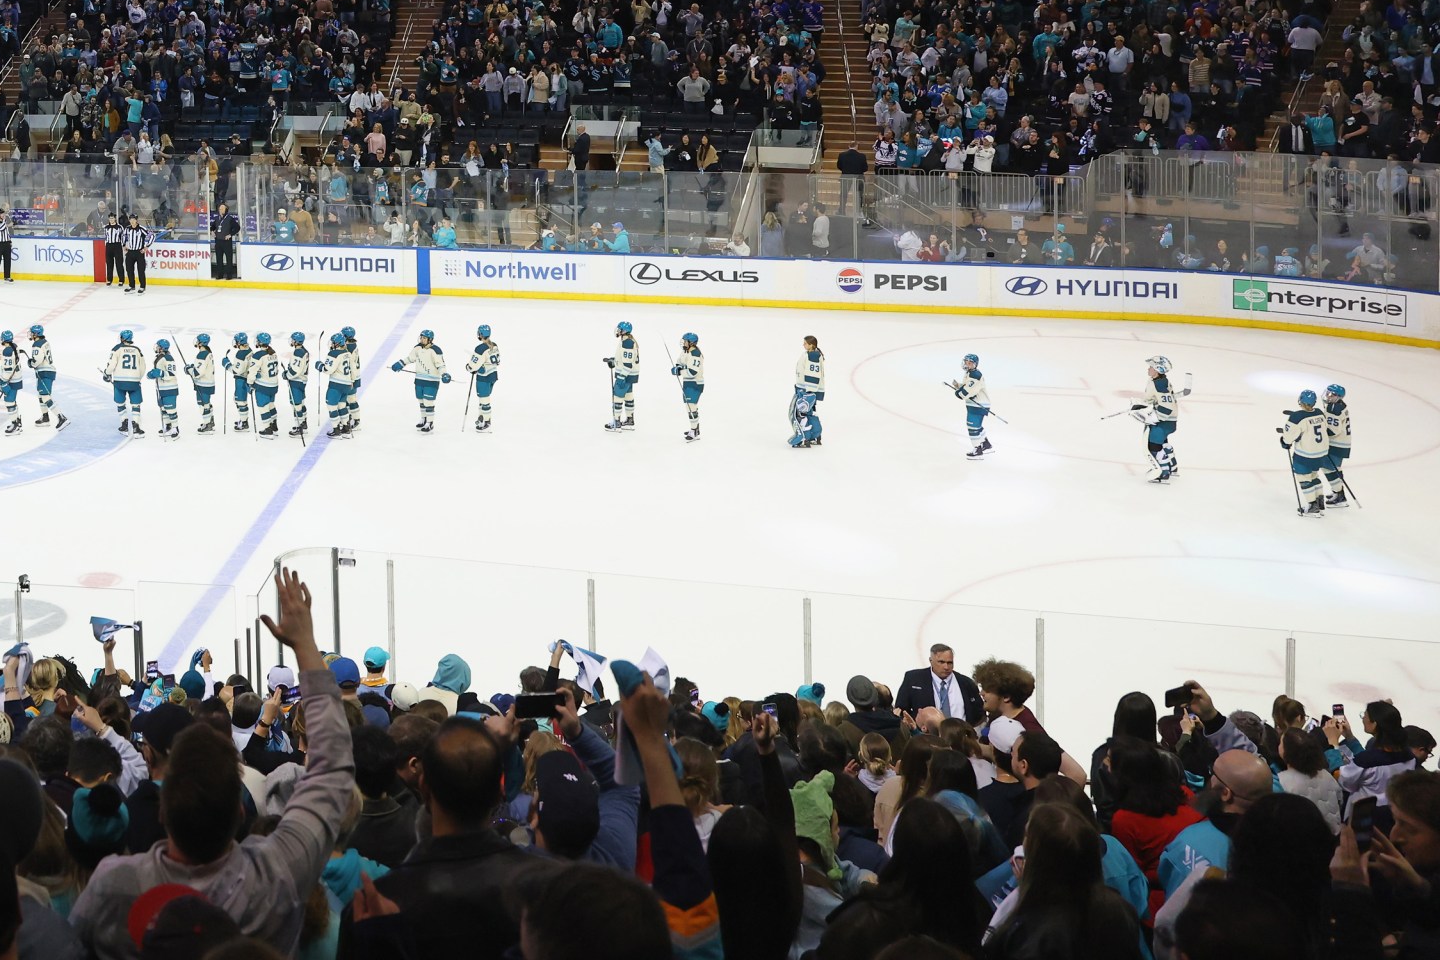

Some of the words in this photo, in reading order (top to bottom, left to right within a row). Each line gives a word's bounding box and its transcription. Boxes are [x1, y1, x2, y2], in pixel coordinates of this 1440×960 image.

[34, 244, 84, 266] Infosys
[155, 249, 176, 259] FOR
[160, 261, 201, 271] DUNKIN'
[300, 256, 395, 275] HYUNDAI
[465, 260, 578, 282] Northwell
[665, 267, 760, 284] LEXUS
[838, 276, 863, 285] PEPSI
[873, 273, 949, 293] PEPSI
[1056, 279, 1179, 301] HYUNDAI
[1243, 283, 1404, 319] enterprise
[623, 351, 633, 359] 88
[122, 354, 138, 370] 21
[292, 359, 301, 367] 71
[324, 358, 334, 366] 24
[810, 365, 820, 373] 83
[1161, 395, 1172, 403] 30
[1327, 417, 1339, 427] 25
[1313, 425, 1322, 443] 5
